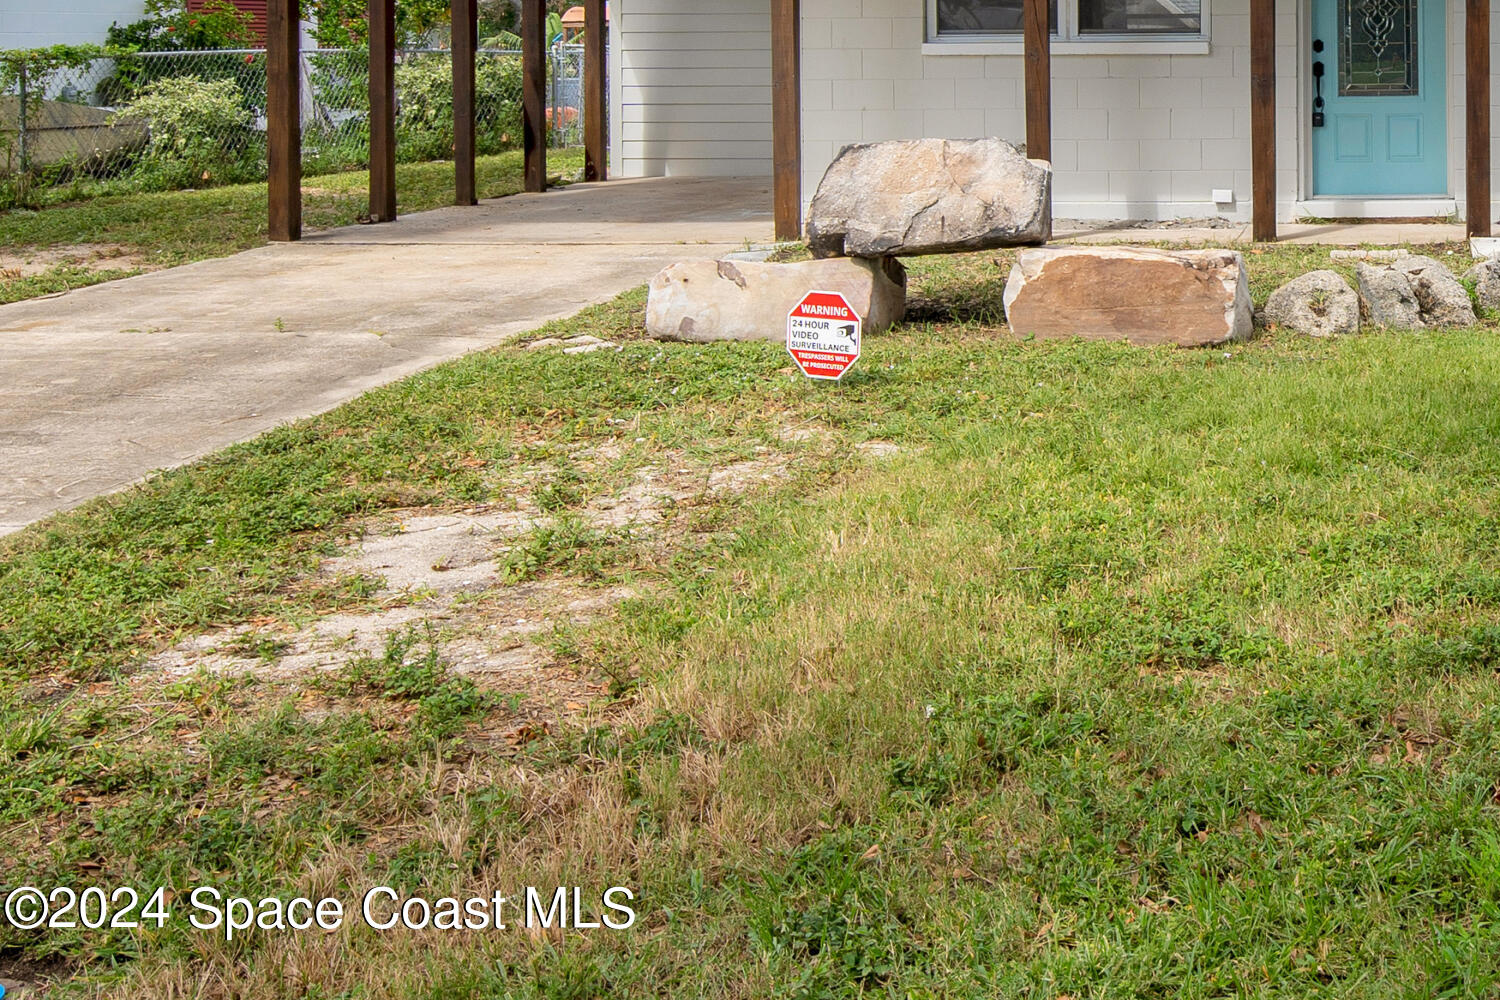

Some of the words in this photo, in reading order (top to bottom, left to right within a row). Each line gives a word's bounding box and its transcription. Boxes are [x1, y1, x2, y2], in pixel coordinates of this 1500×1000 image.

[800, 304, 848, 317] WARNING
[805, 320, 829, 330] HOUR
[792, 331, 818, 339] VIDEO
[791, 341, 849, 352] SURVEILLANCE
[798, 352, 834, 361] TRESPASSERS
